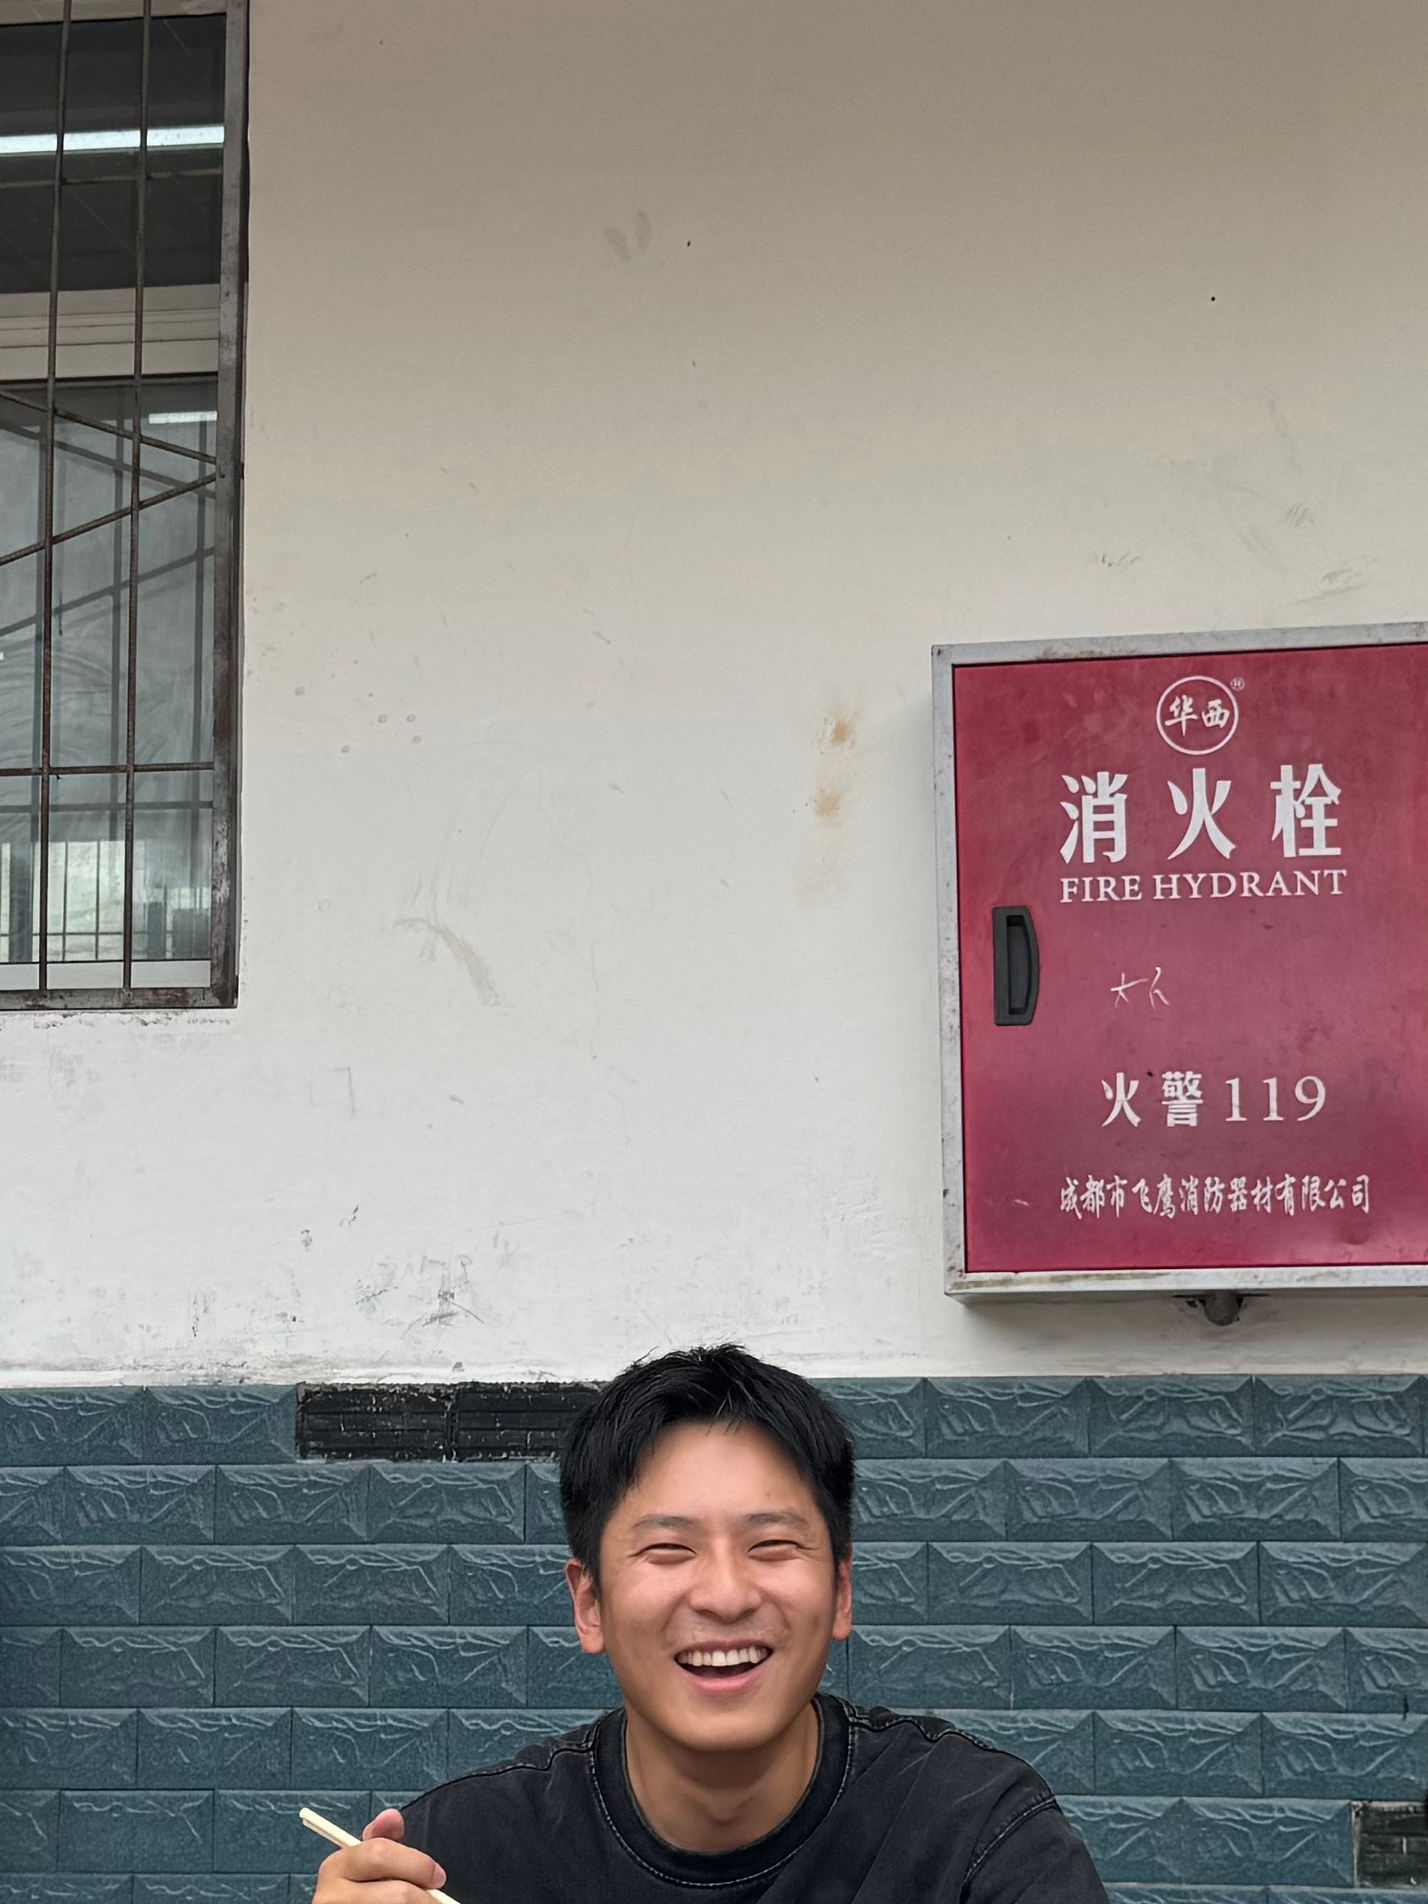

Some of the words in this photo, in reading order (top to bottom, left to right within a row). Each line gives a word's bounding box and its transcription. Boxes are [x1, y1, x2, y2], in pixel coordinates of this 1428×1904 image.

[1164, 694, 1230, 737] 华西
[1059, 763, 1342, 864] 消火栓
[1060, 875, 1142, 903] FIRE
[1152, 869, 1347, 900] HYDRANT
[1101, 1070, 1204, 1127] 火警
[1225, 1075, 1326, 1122] 119
[1060, 1173, 1369, 1220] 成都市飞鹰消防器材有限公司
